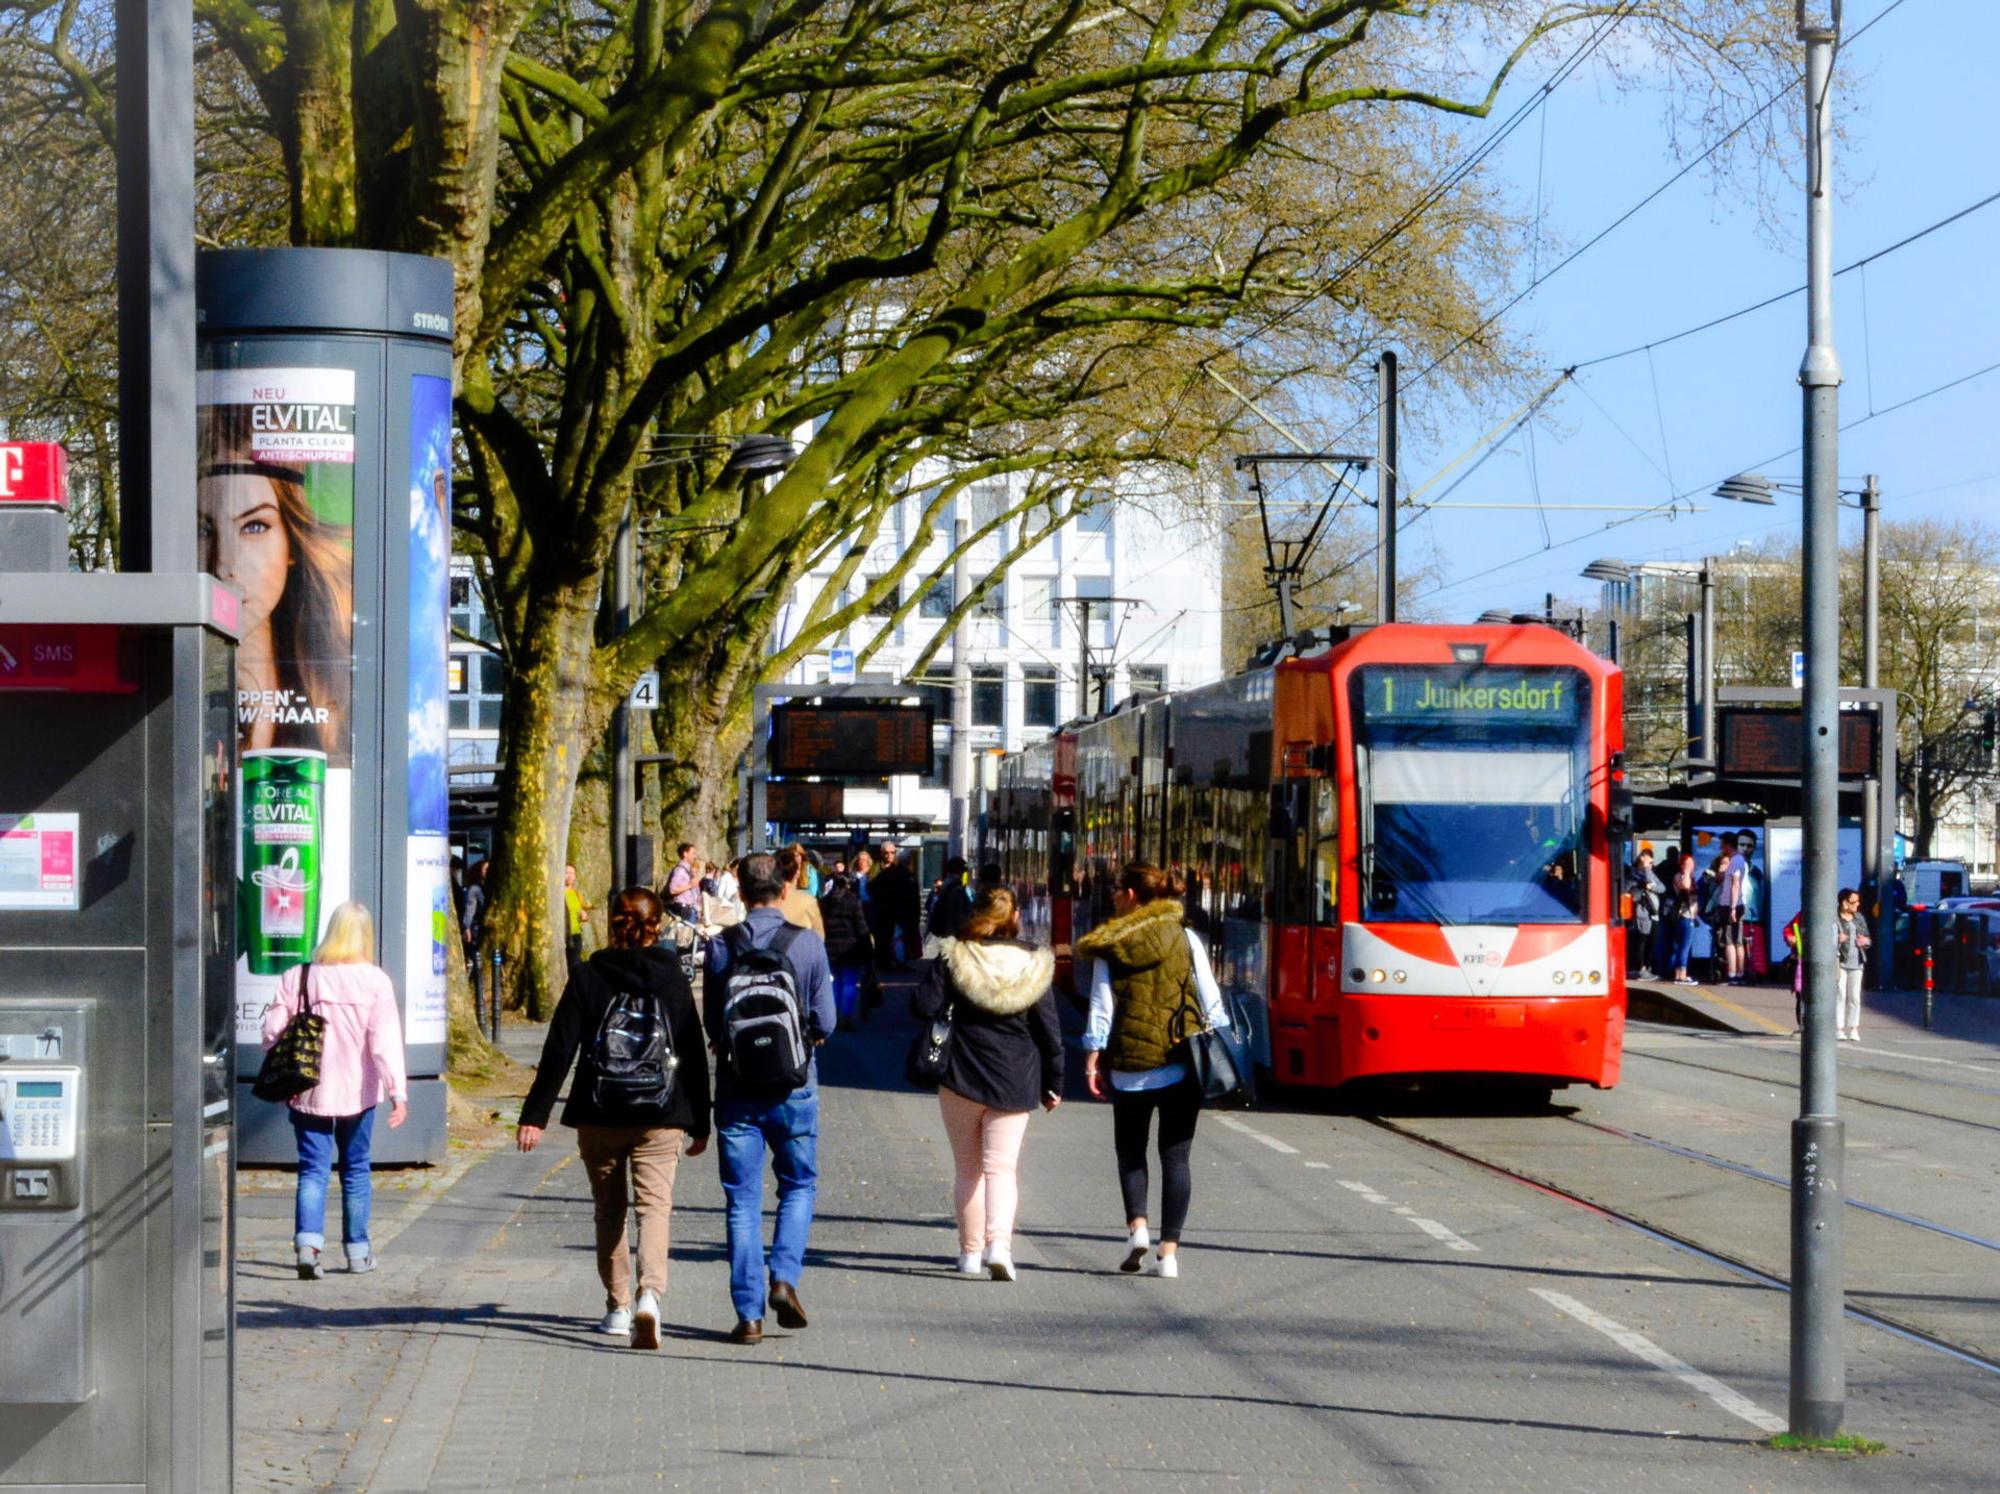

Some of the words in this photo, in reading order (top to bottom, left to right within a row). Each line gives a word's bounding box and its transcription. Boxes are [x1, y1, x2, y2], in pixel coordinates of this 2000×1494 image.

[253, 388, 285, 400] NEU
[252, 405, 347, 432] ELVITAL
[259, 437, 304, 447] PLANTA
[308, 438, 347, 447] CLEAR
[258, 451, 347, 461] ANTI-SCHUPPEN
[34, 645, 73, 661] SMS
[636, 683, 654, 704] 4
[1383, 677, 1394, 713] 1
[1417, 679, 1562, 710] Junkersdorf
[254, 803, 313, 821] ELVITAL
